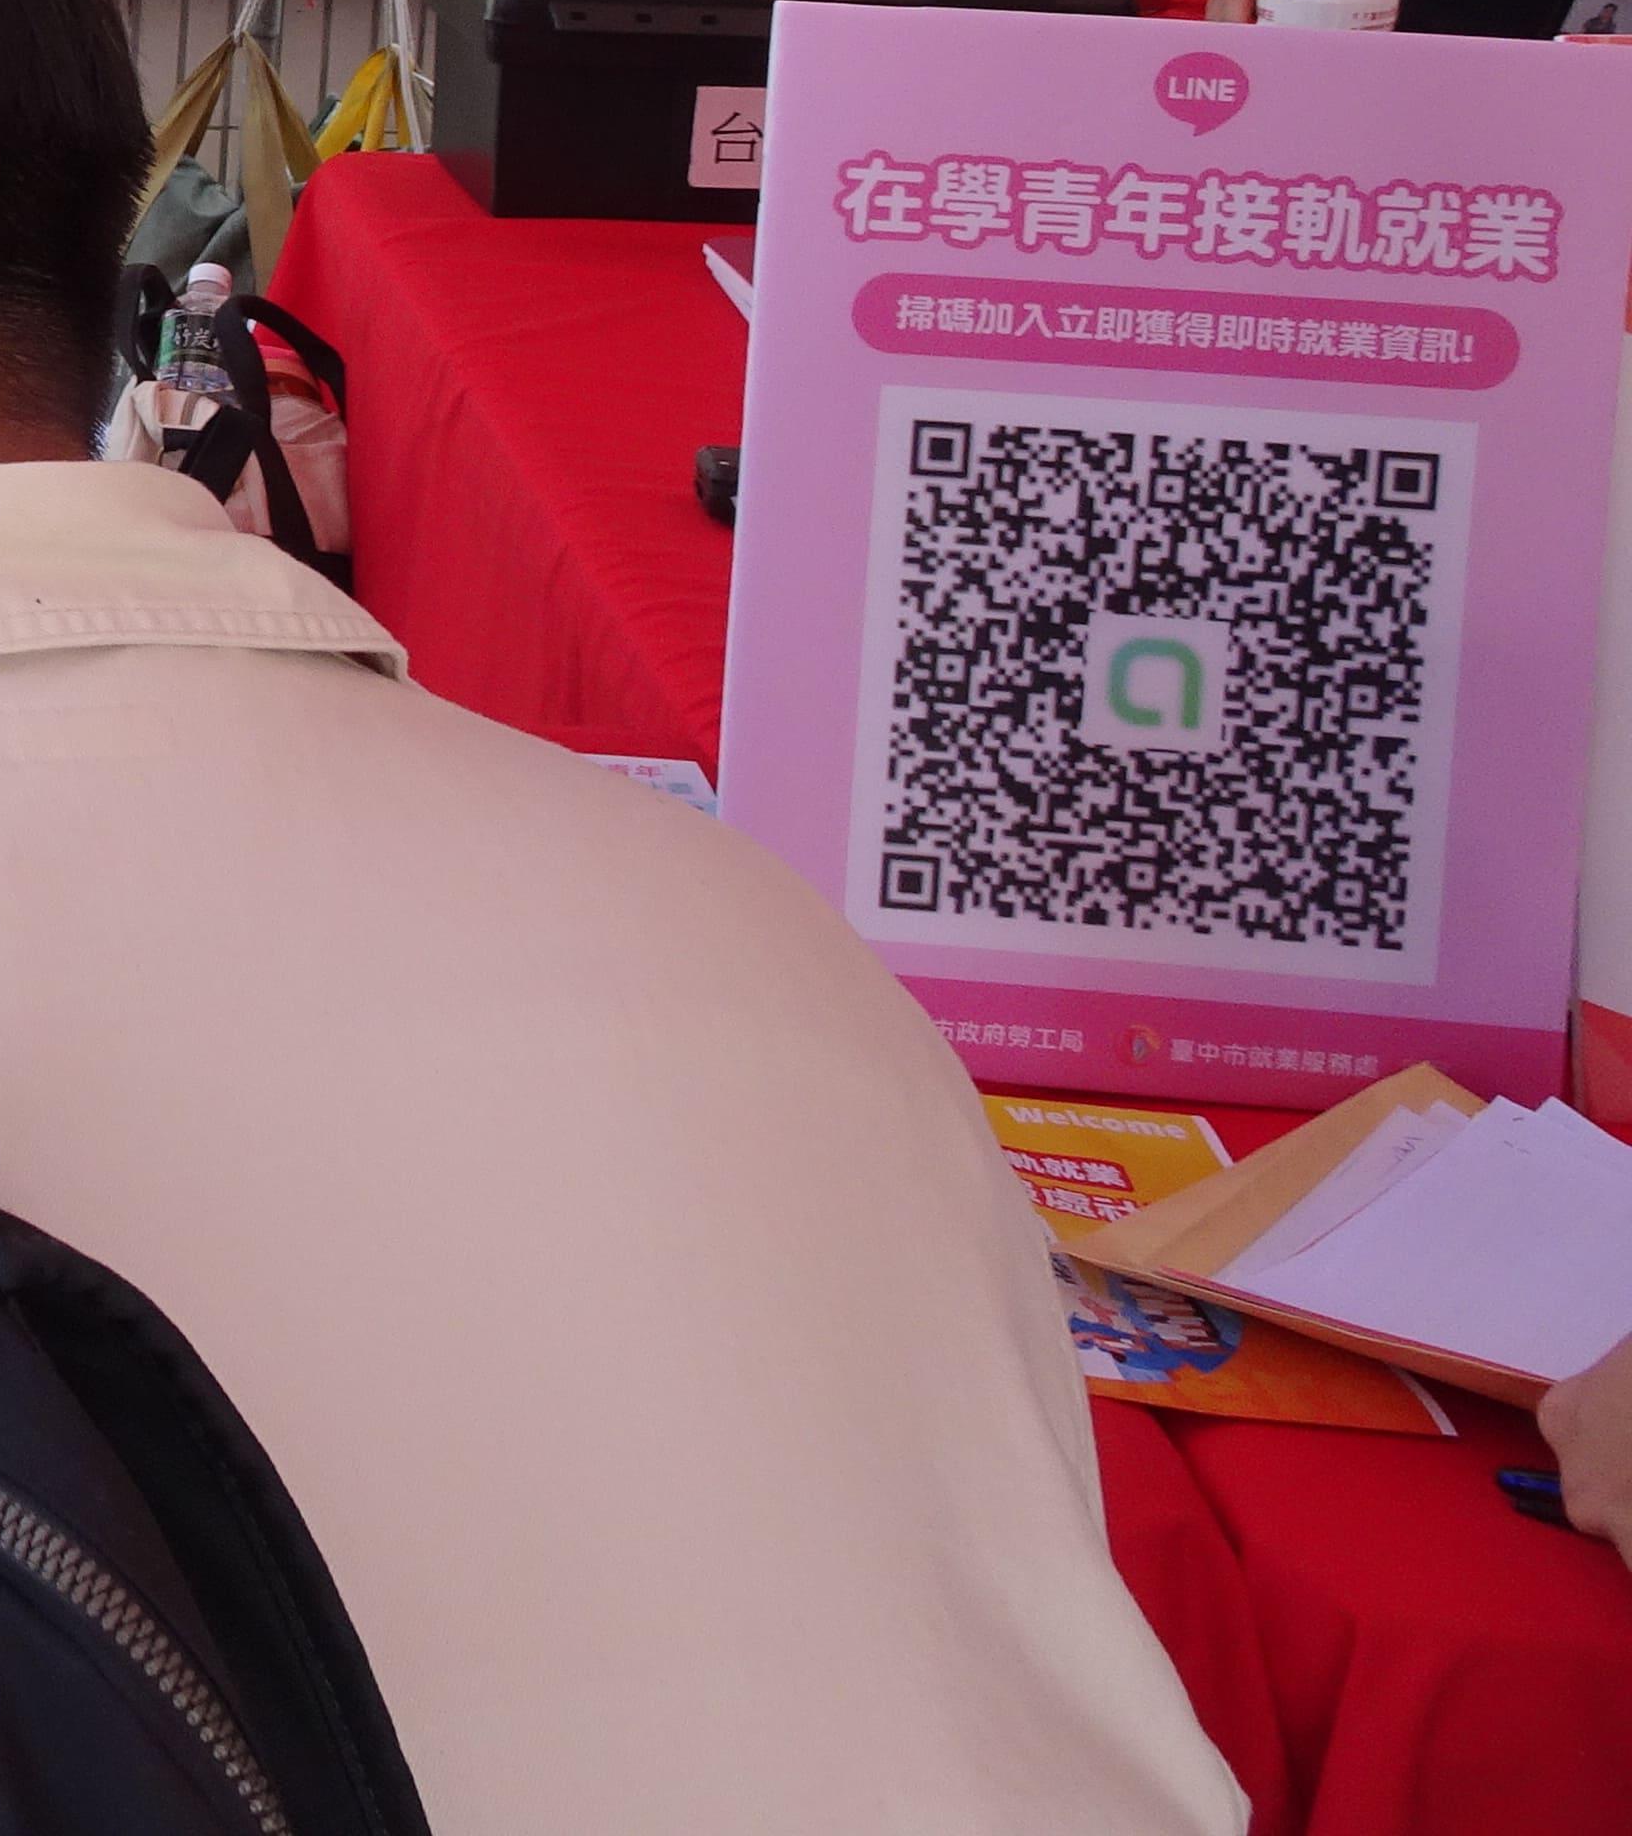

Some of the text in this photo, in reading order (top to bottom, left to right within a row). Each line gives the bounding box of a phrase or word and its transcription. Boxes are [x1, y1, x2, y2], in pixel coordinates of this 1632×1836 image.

[1167, 75, 1238, 104] LINE
[840, 157, 1559, 275] 在學青年接軌就業
[896, 293, 1474, 365] 掃碼加入立即獲得即時就業資訊!
[1004, 1105, 1187, 1141] Welcome
